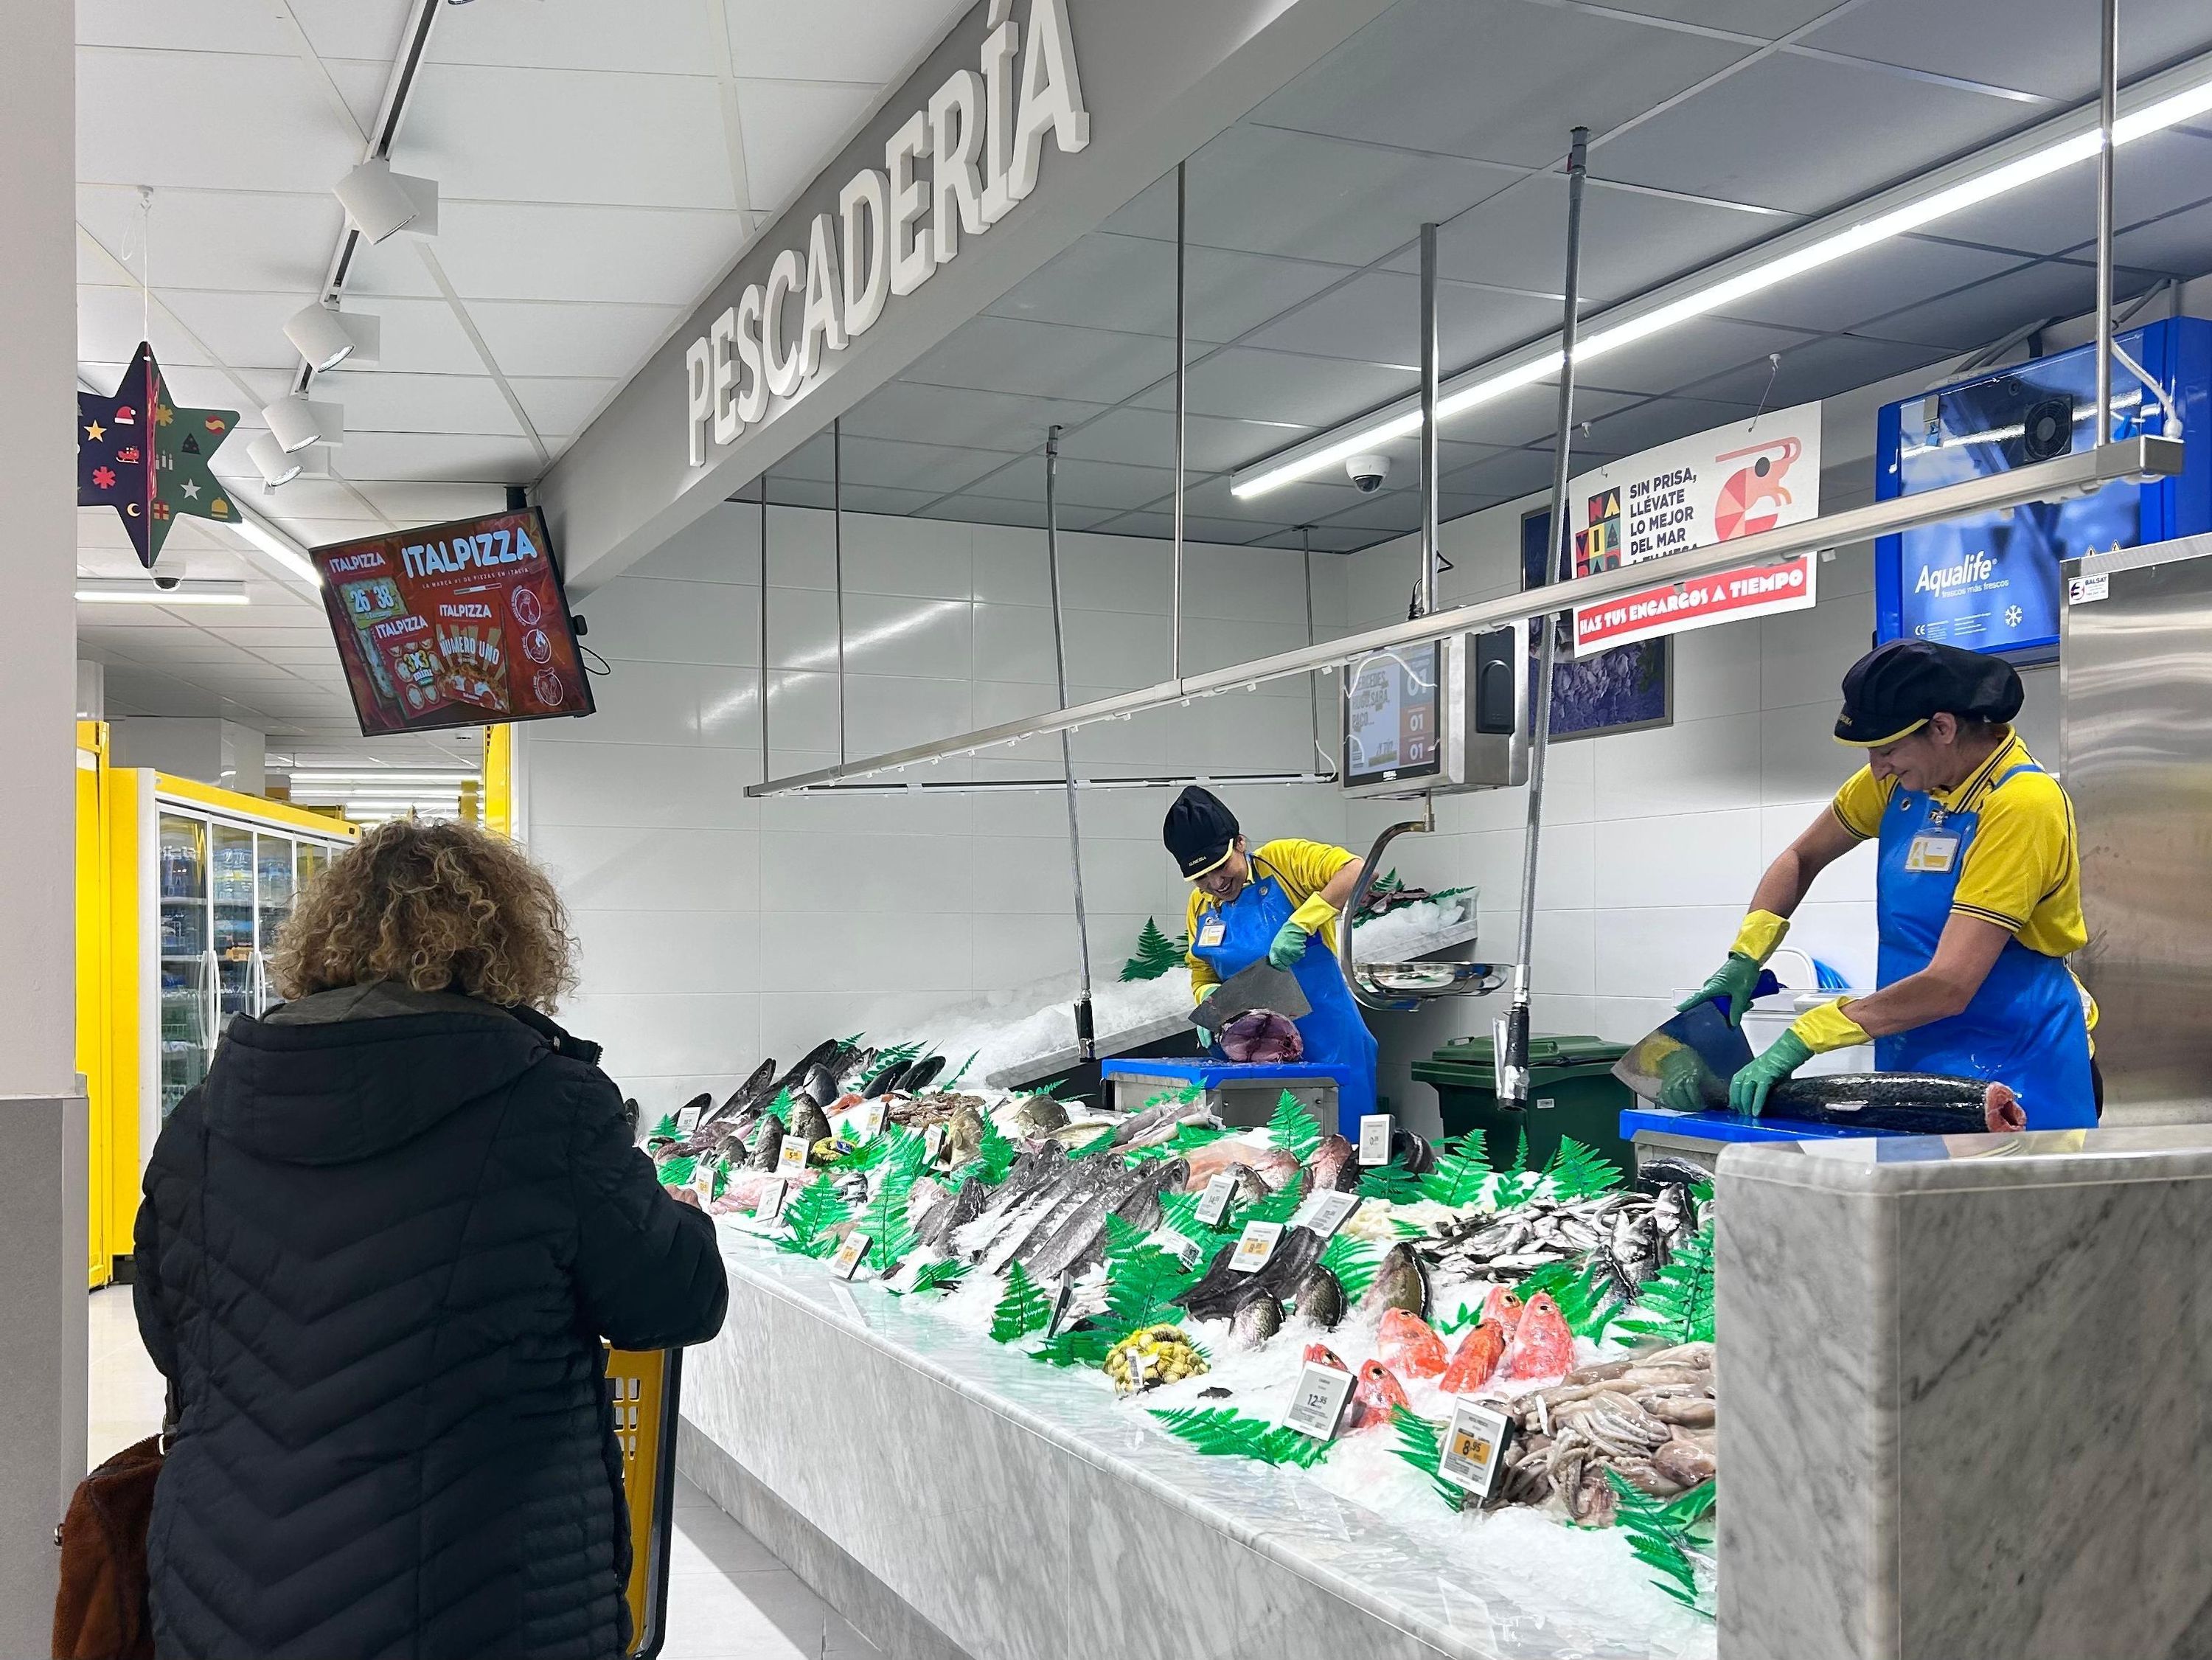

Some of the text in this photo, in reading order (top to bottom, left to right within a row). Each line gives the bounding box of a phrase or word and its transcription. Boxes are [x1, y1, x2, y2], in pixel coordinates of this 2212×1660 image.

[686, 0, 1090, 468] PESCADERÍA
[1630, 467, 1697, 499] SIN PRISA,
[1630, 487, 1686, 518] LLÉVATE
[1630, 505, 1694, 538] LO MEJOR
[401, 527, 538, 579] ITALPIZZA
[1630, 536, 1653, 556] DEL
[1656, 527, 1686, 549] MAR
[329, 552, 386, 574] ITALPIZZA
[432, 579, 453, 588] MARCA
[463, 575, 472, 583] DE
[473, 572, 495, 582] PIZZAS
[507, 566, 530, 577] ITALIA
[350, 584, 394, 614] 26 38
[439, 603, 493, 619] ITALPIZZA
[1579, 569, 1804, 636] HAZ TUS ENCARGOS A TIEMPO
[375, 614, 429, 639] ITALPIZZA
[478, 639, 501, 665] UNO
[1406, 667, 1427, 697] 01
[1410, 712, 1424, 732] 01
[1410, 742, 1424, 761] 01
